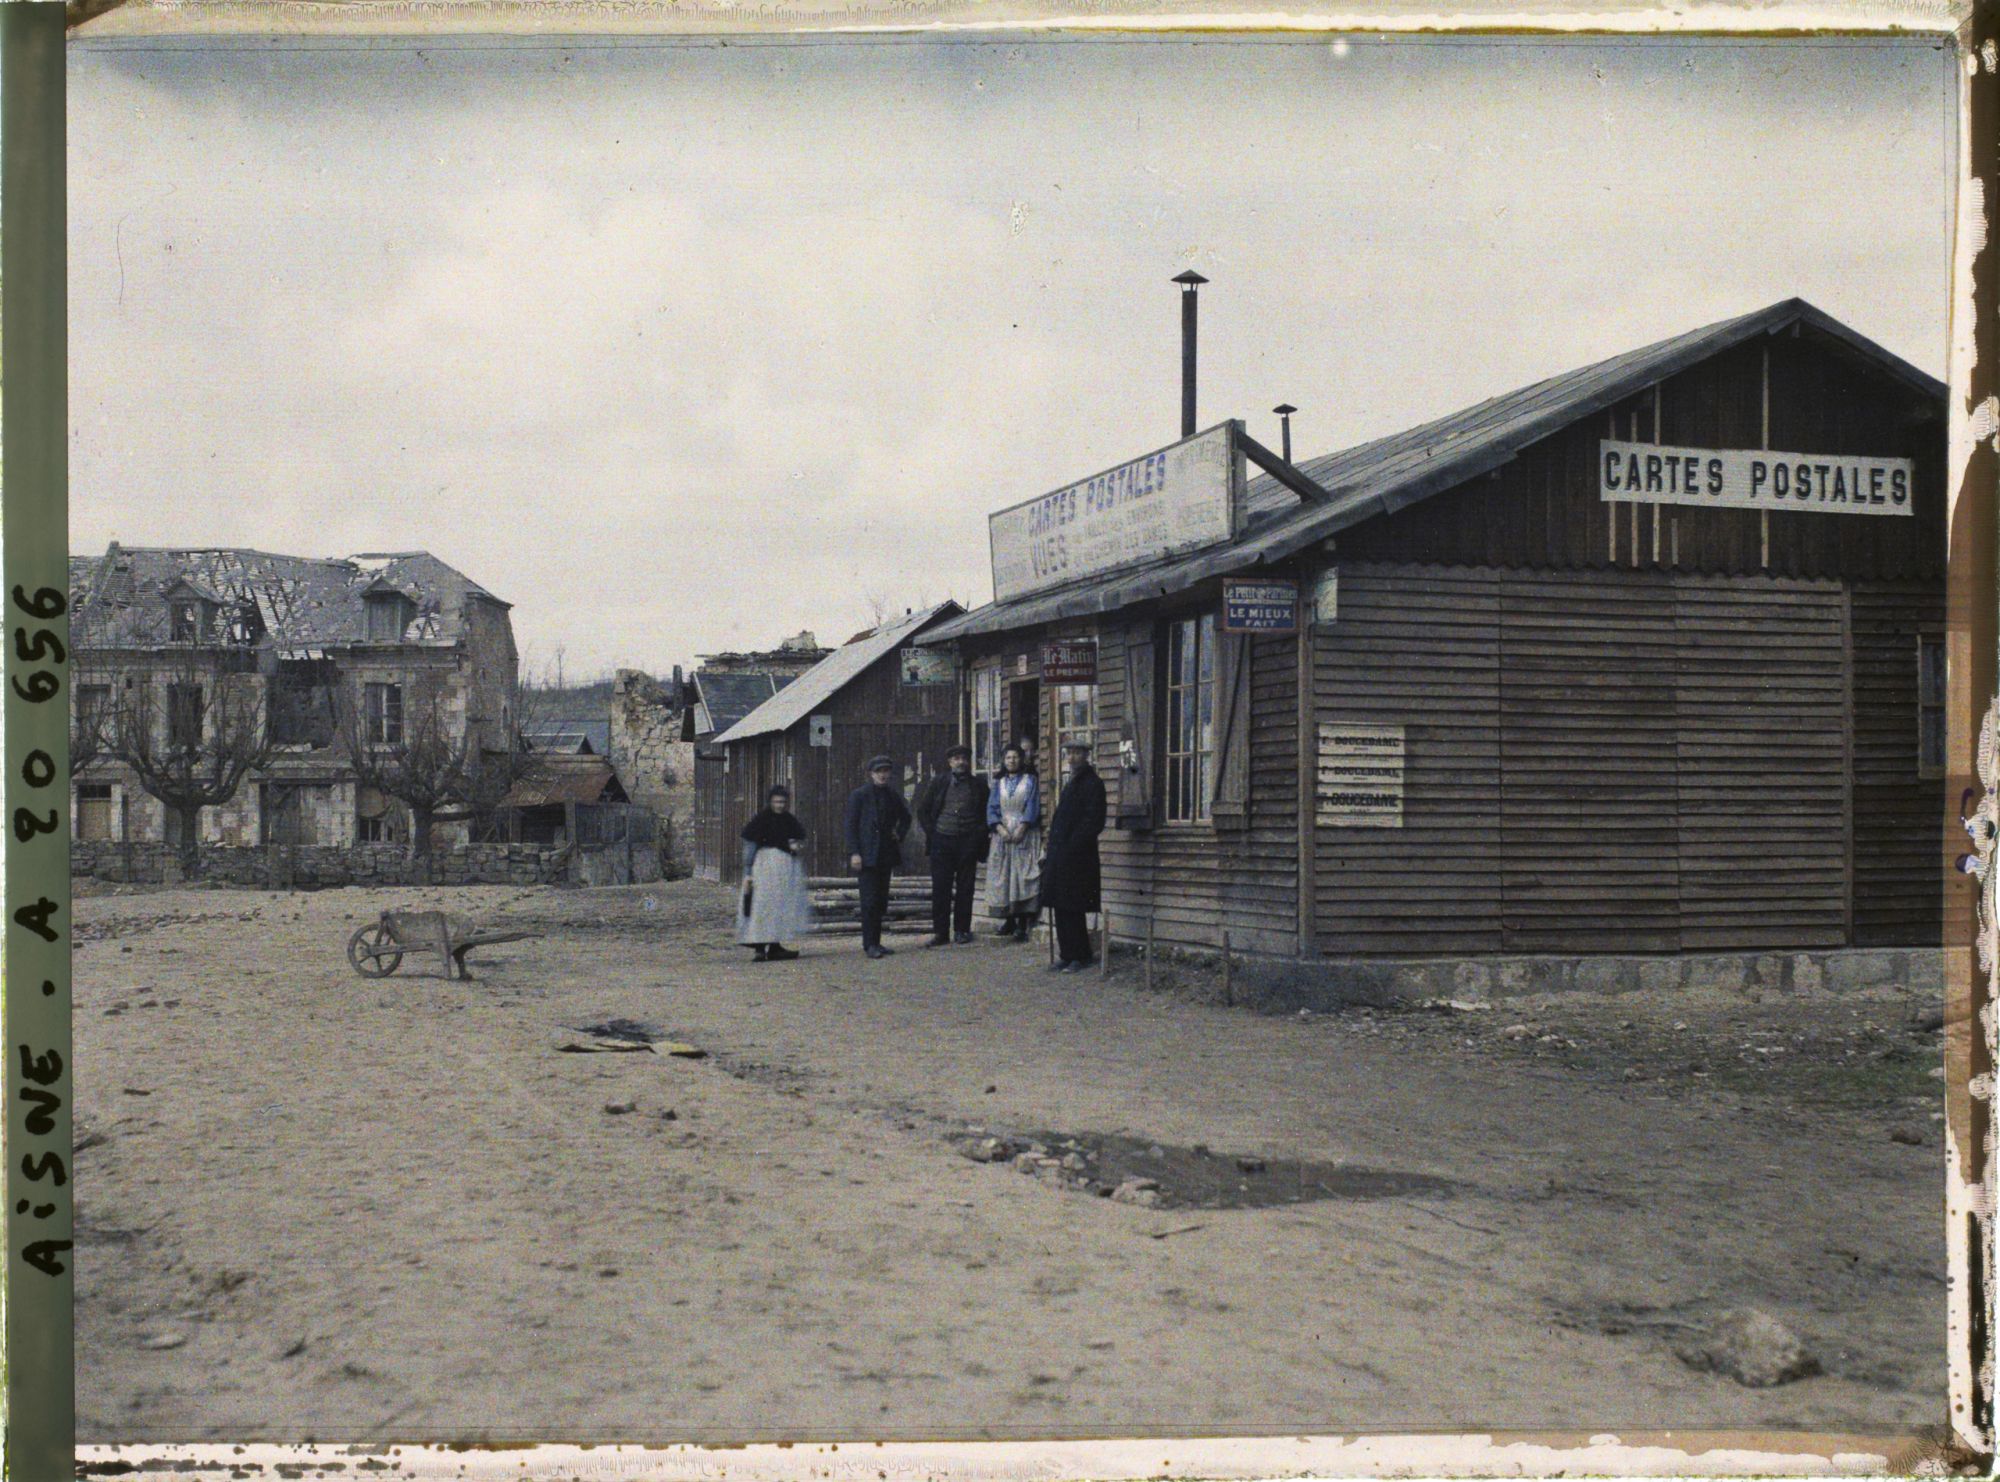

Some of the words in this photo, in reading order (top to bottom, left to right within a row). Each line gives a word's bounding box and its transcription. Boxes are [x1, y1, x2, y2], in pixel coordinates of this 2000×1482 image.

[1028, 488, 1077, 538] CARTES
[1086, 452, 1166, 516] POSTALES
[1604, 451, 1724, 496] CARTES
[1750, 460, 1908, 505] POSTALES
[12, 585, 68, 703] 656
[1230, 607, 1245, 618] LE
[1249, 608, 1292, 619] MIEUX
[14, 750, 58, 842] 20
[14, 896, 59, 942] A
